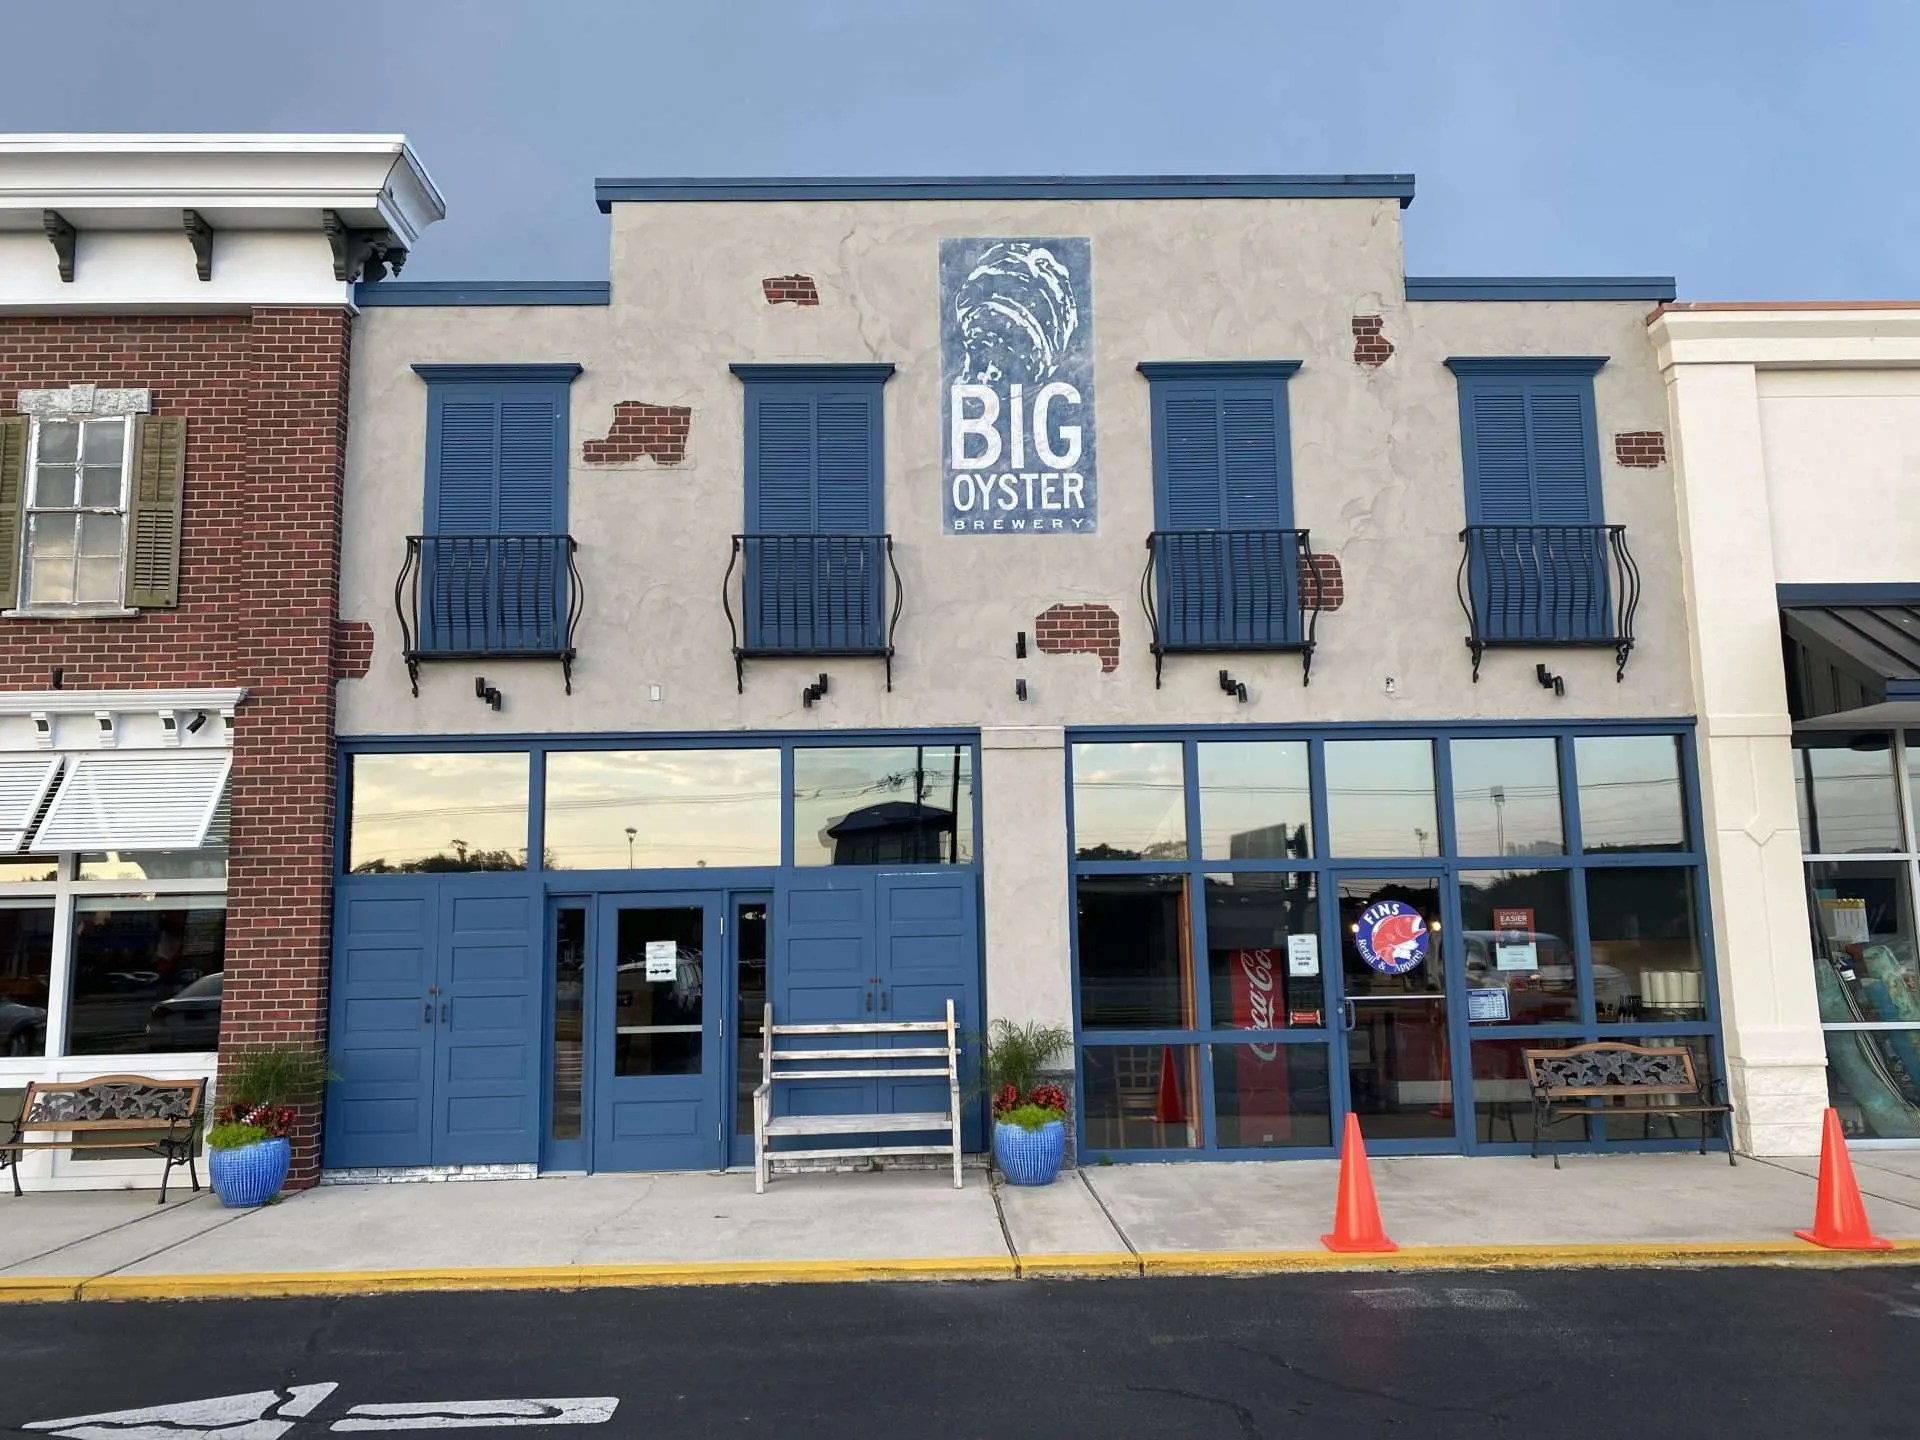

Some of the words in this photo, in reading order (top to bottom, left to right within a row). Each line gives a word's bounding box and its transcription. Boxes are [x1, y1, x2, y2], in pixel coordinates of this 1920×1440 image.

[951, 382, 1082, 470] BIG
[952, 473, 1085, 512] OYSTER
[954, 518, 1084, 530] BREWERY
[1363, 903, 1400, 925] FINS
[1359, 939, 1377, 964] Retail
[1378, 961, 1386, 971] &
[1394, 949, 1424, 973] Apparel
